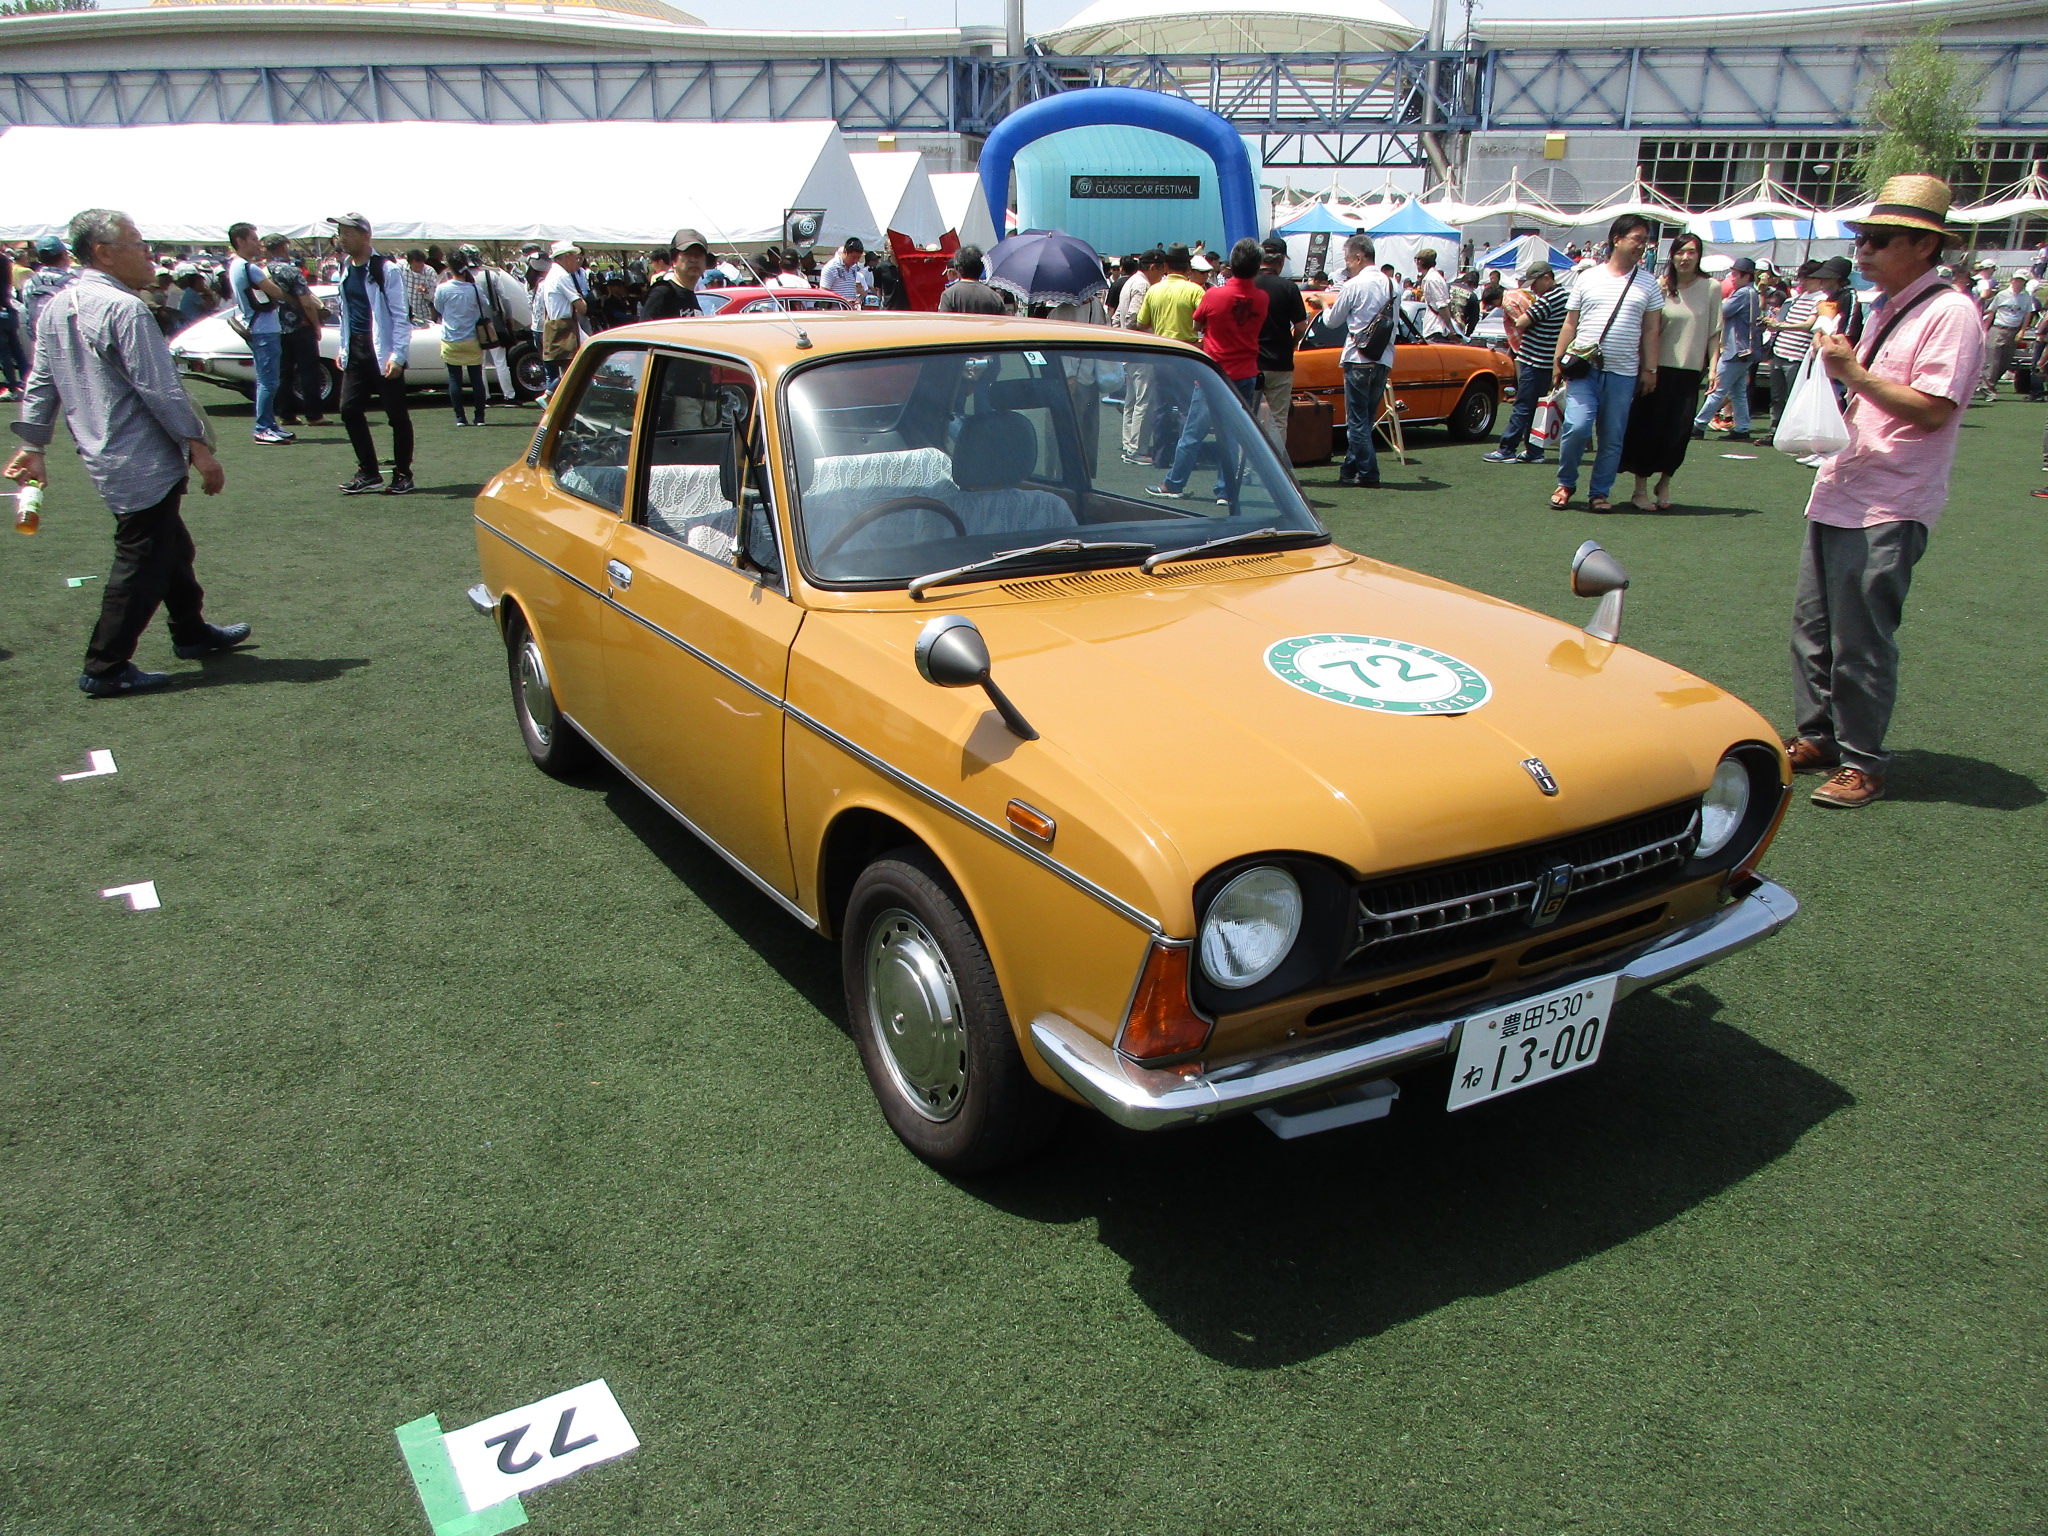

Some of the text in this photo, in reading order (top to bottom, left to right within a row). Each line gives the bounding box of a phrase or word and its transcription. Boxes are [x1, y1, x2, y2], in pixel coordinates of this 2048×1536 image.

[1096, 184, 1193, 195] CLASSIC CAR FESTIVAL
[1028, 352, 1036, 361] 9
[1287, 635, 1483, 689] CAR FESTIVAL
[1318, 654, 1439, 689] 72
[1273, 651, 1386, 709] CLASSIC
[1419, 694, 1475, 711] 2018
[1544, 897, 1563, 914] G
[1460, 1016, 1600, 1092] ね 13-00
[484, 1406, 599, 1475] 72
